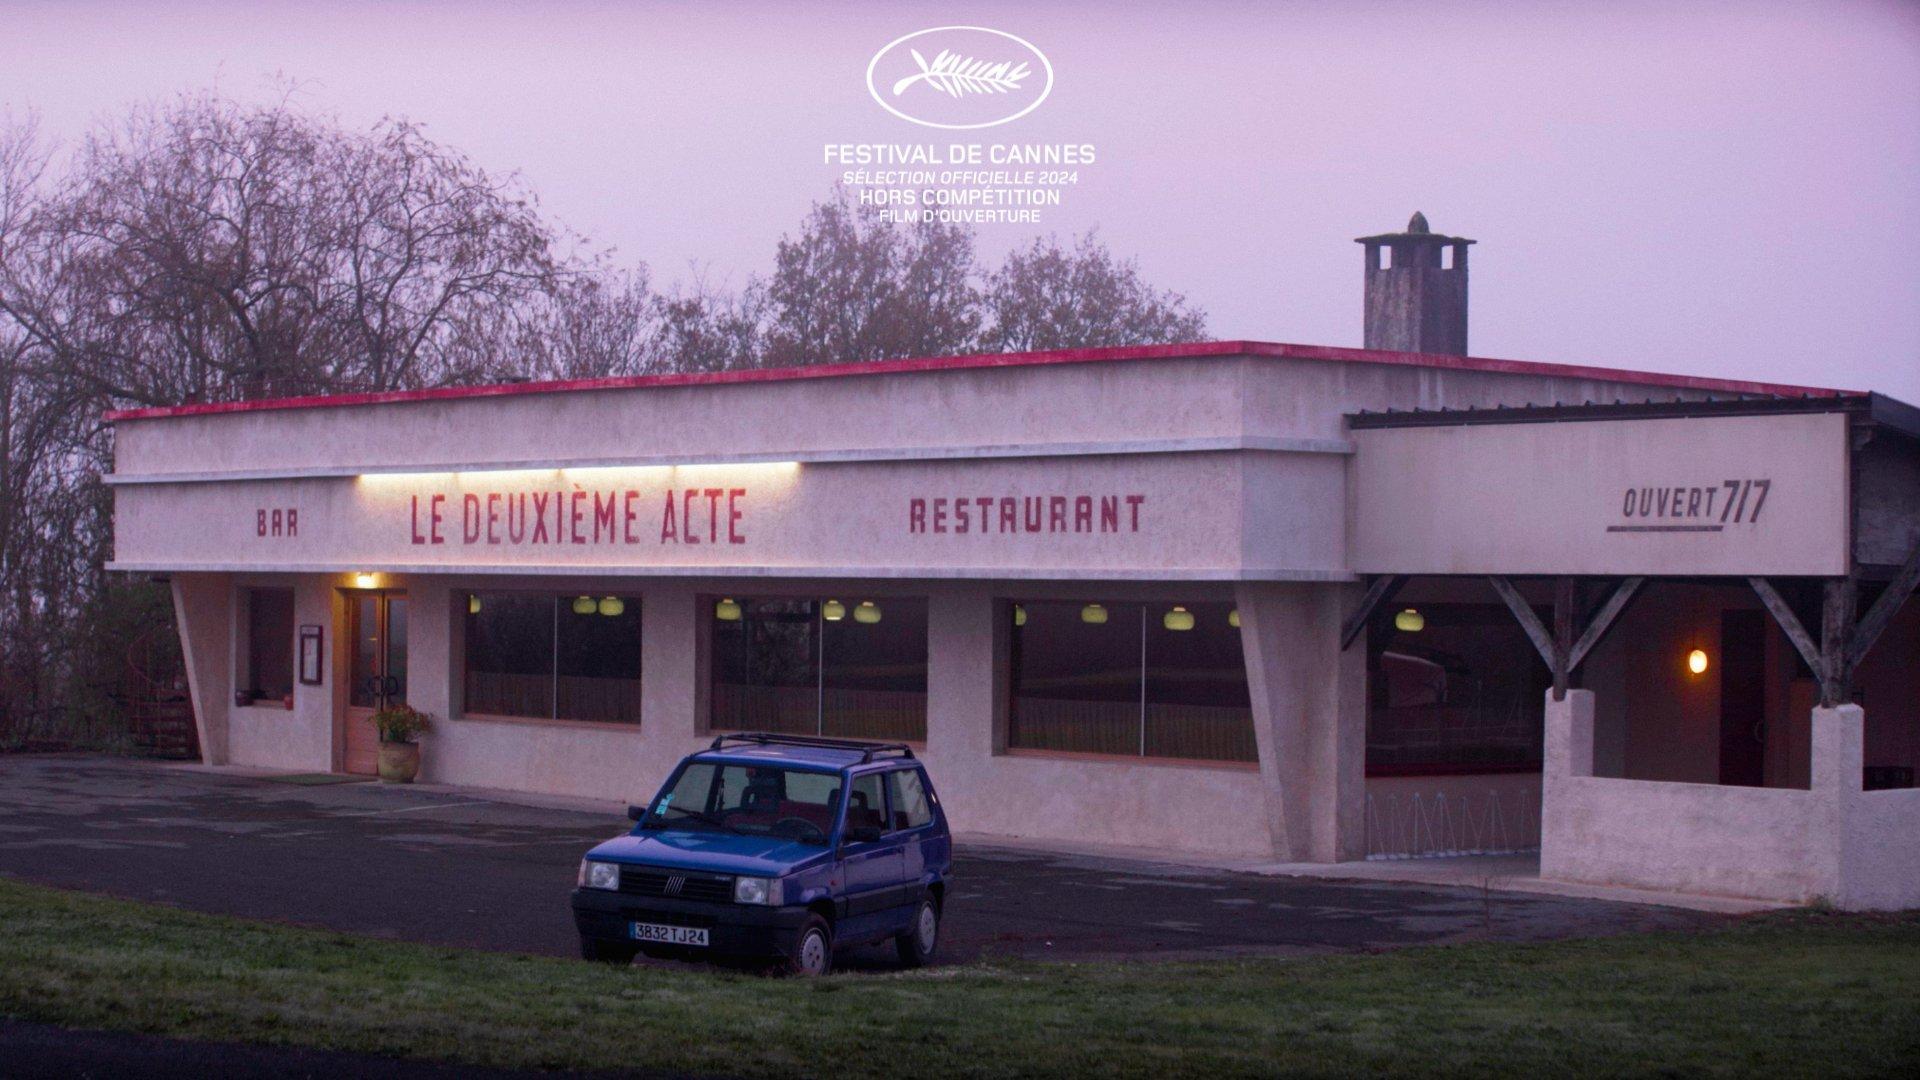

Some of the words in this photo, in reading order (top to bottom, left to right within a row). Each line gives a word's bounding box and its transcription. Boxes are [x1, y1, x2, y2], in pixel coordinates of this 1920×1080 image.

[411, 494, 445, 545] LE
[463, 483, 640, 544] DEUXIÈME
[661, 488, 746, 544] ACTE
[910, 495, 1145, 533] RESTAURANT
[1623, 487, 1717, 517] OUVERT
[1720, 479, 1771, 523] 7/7
[257, 509, 298, 537] BAR
